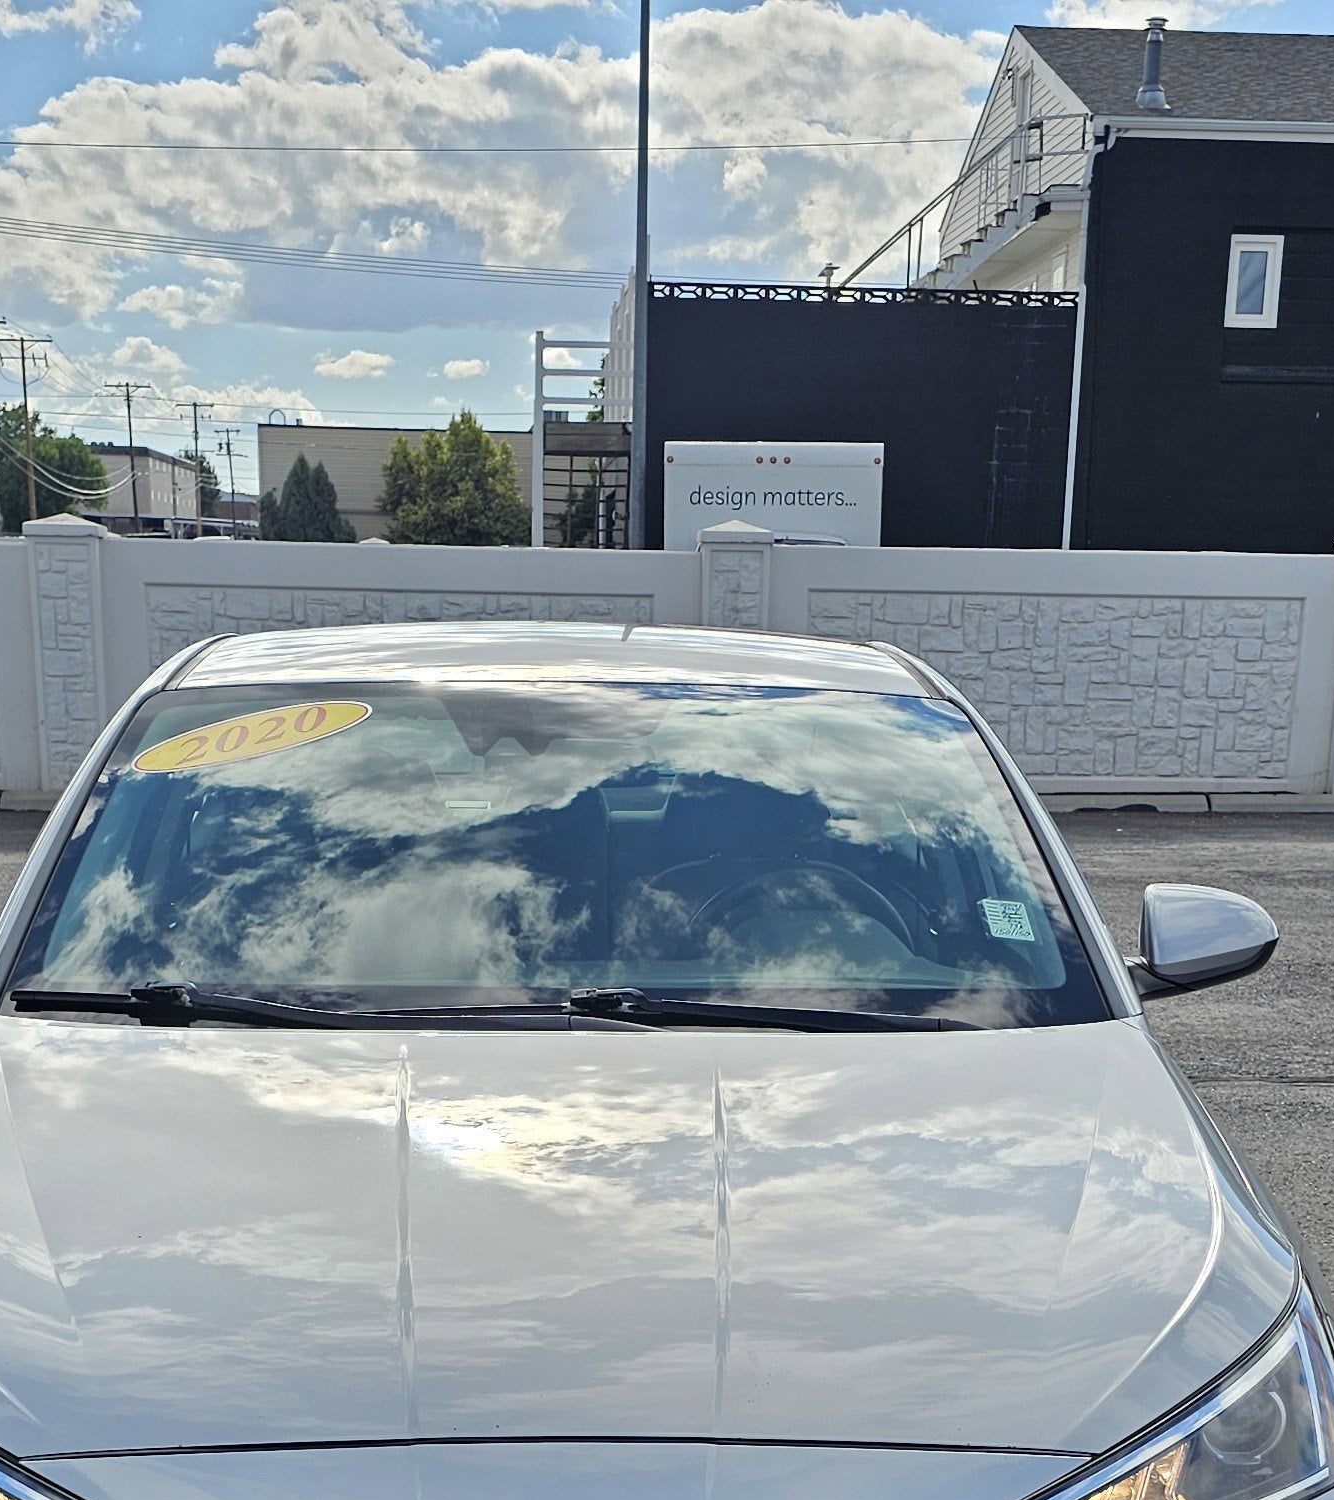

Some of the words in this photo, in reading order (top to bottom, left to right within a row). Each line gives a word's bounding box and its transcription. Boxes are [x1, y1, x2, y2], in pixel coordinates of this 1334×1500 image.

[689, 485, 756, 511] design
[763, 489, 857, 507] matters...
[175, 704, 328, 766] 2020
